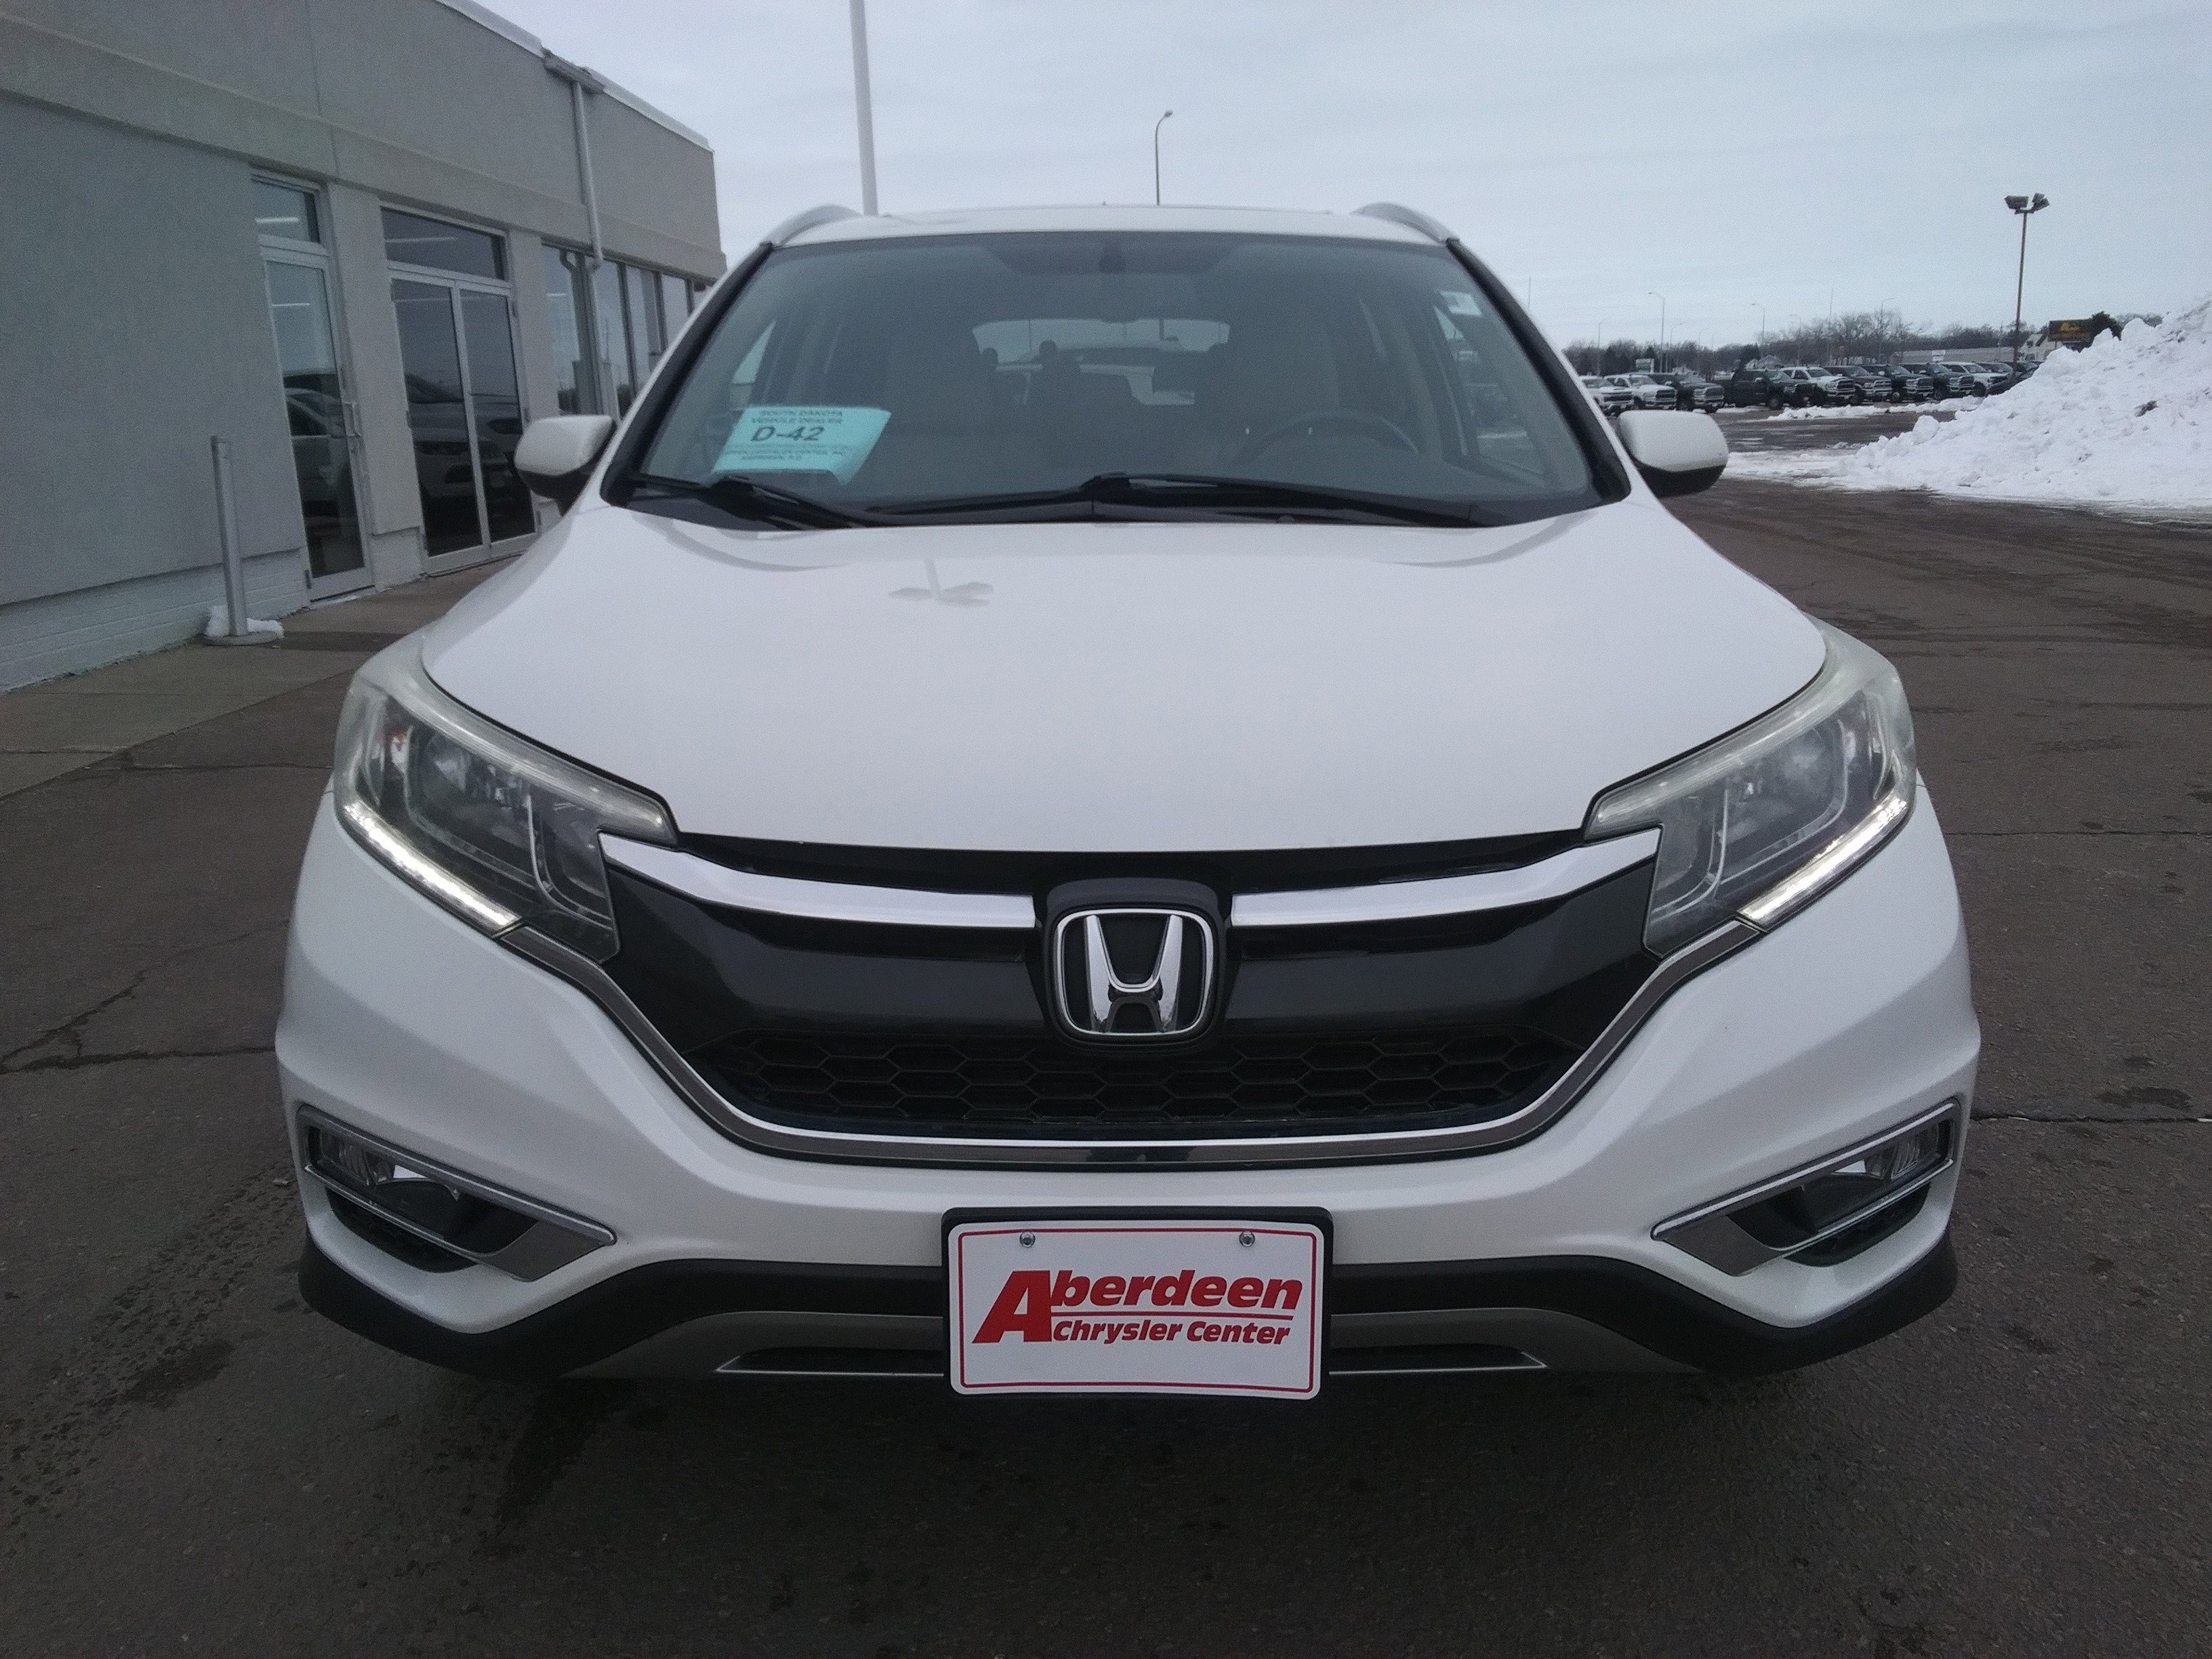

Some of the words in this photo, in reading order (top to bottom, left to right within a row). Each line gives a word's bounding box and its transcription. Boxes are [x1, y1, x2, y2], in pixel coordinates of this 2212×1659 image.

[750, 426, 825, 441] D-42
[972, 1269, 1303, 1344] Aberdeen
[1052, 1319, 1182, 1345] Chrysler
[1187, 1320, 1291, 1345] Center
